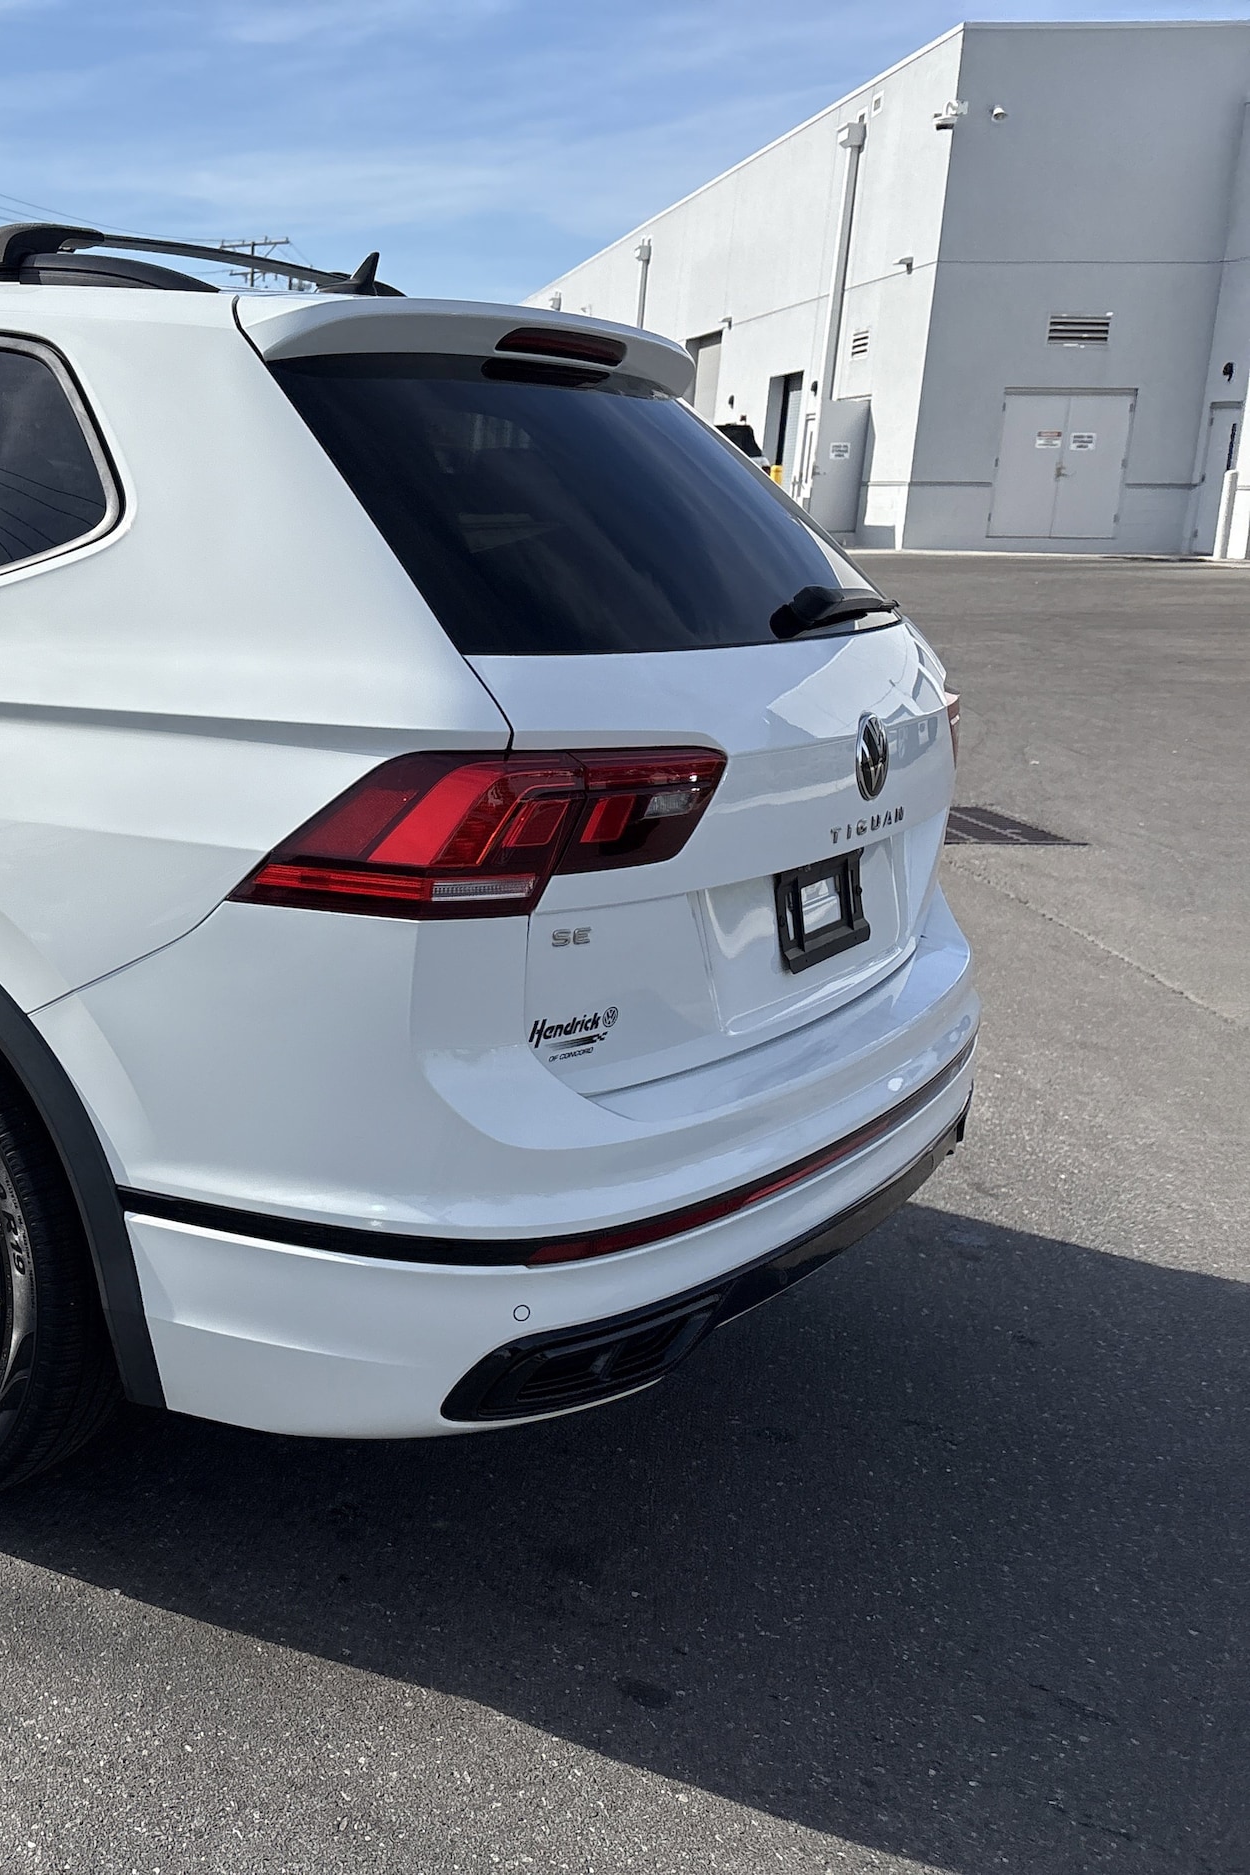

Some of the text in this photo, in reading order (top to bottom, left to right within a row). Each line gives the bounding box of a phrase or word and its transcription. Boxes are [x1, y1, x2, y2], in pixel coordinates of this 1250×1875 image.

[830, 806, 904, 844] TIGUAN
[551, 926, 592, 948] SE
[528, 1012, 602, 1049] Hendrick
